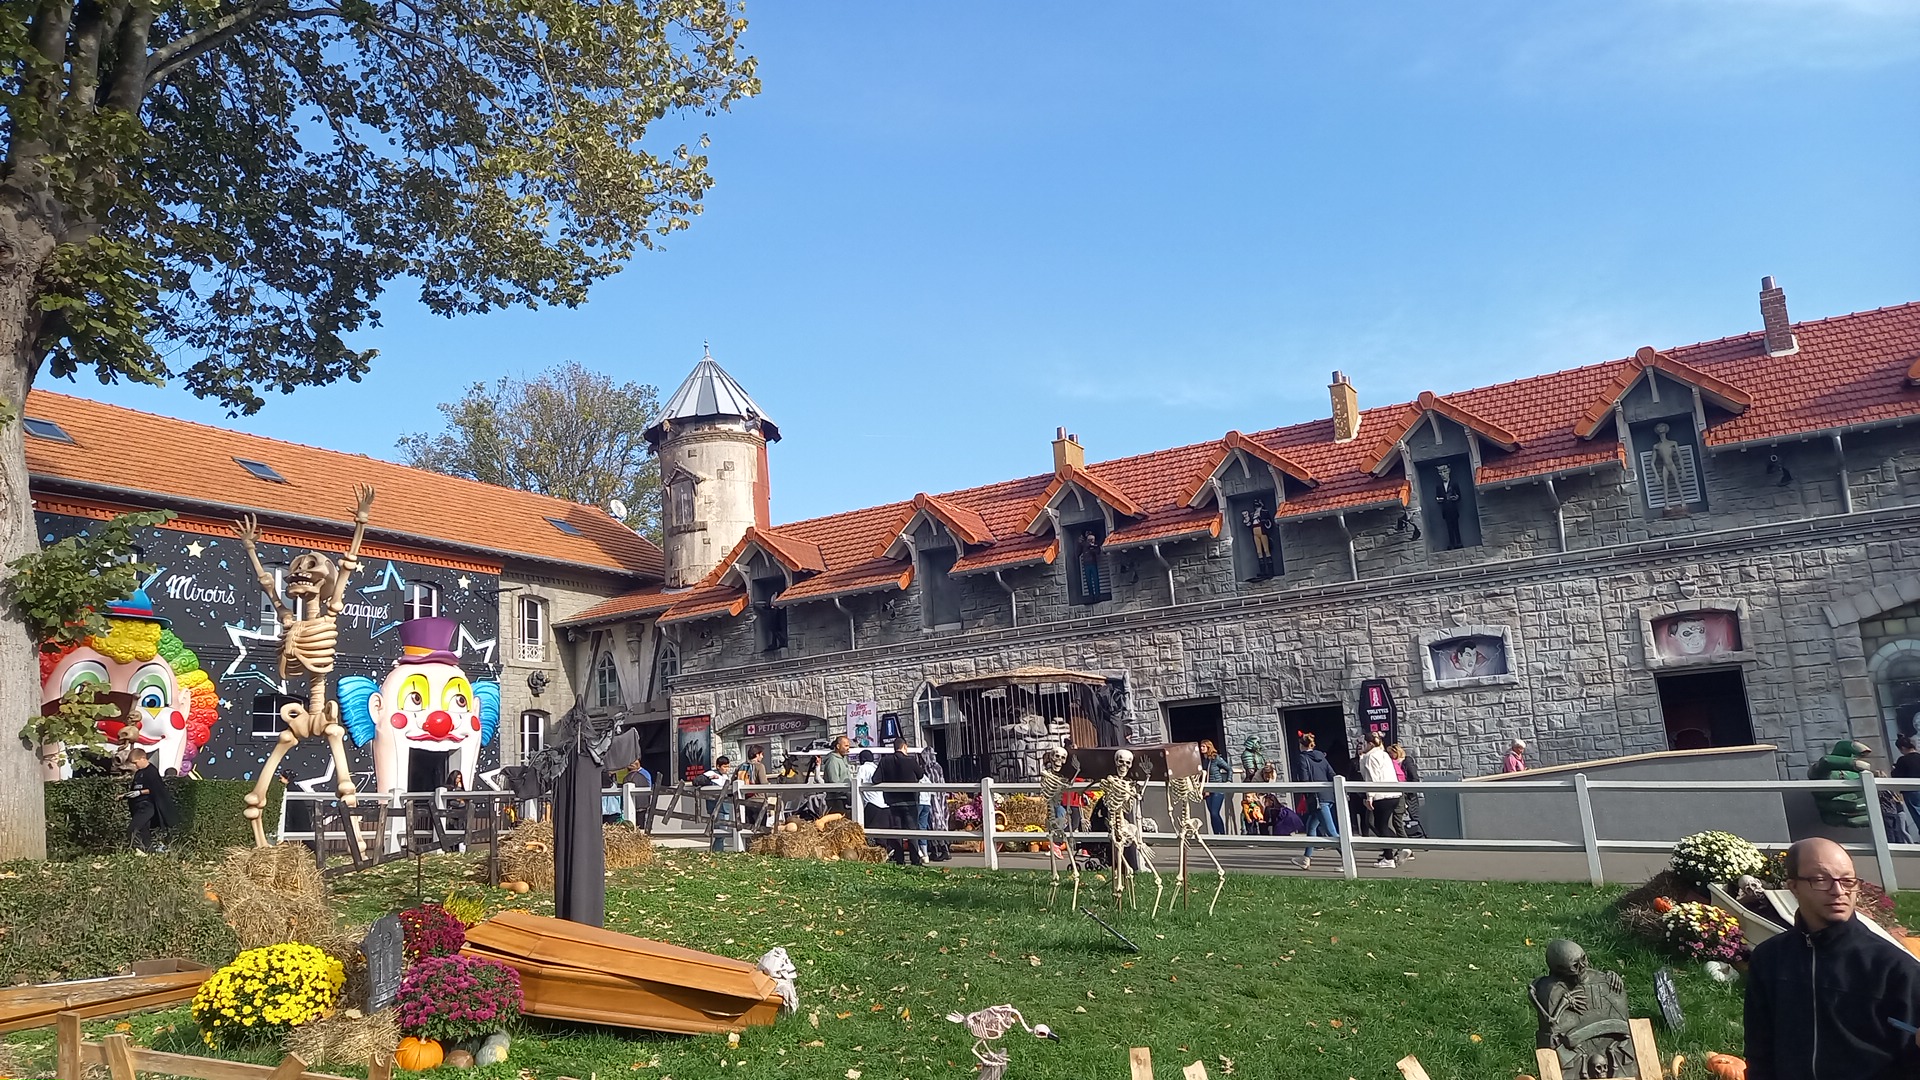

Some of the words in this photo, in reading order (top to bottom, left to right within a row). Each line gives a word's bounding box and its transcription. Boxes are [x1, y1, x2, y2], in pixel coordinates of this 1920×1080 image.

[165, 574, 236, 606] Miroirs
[339, 600, 389, 629] agiques
[757, 722, 779, 733] PETIT
[780, 720, 801, 731] BOBO
